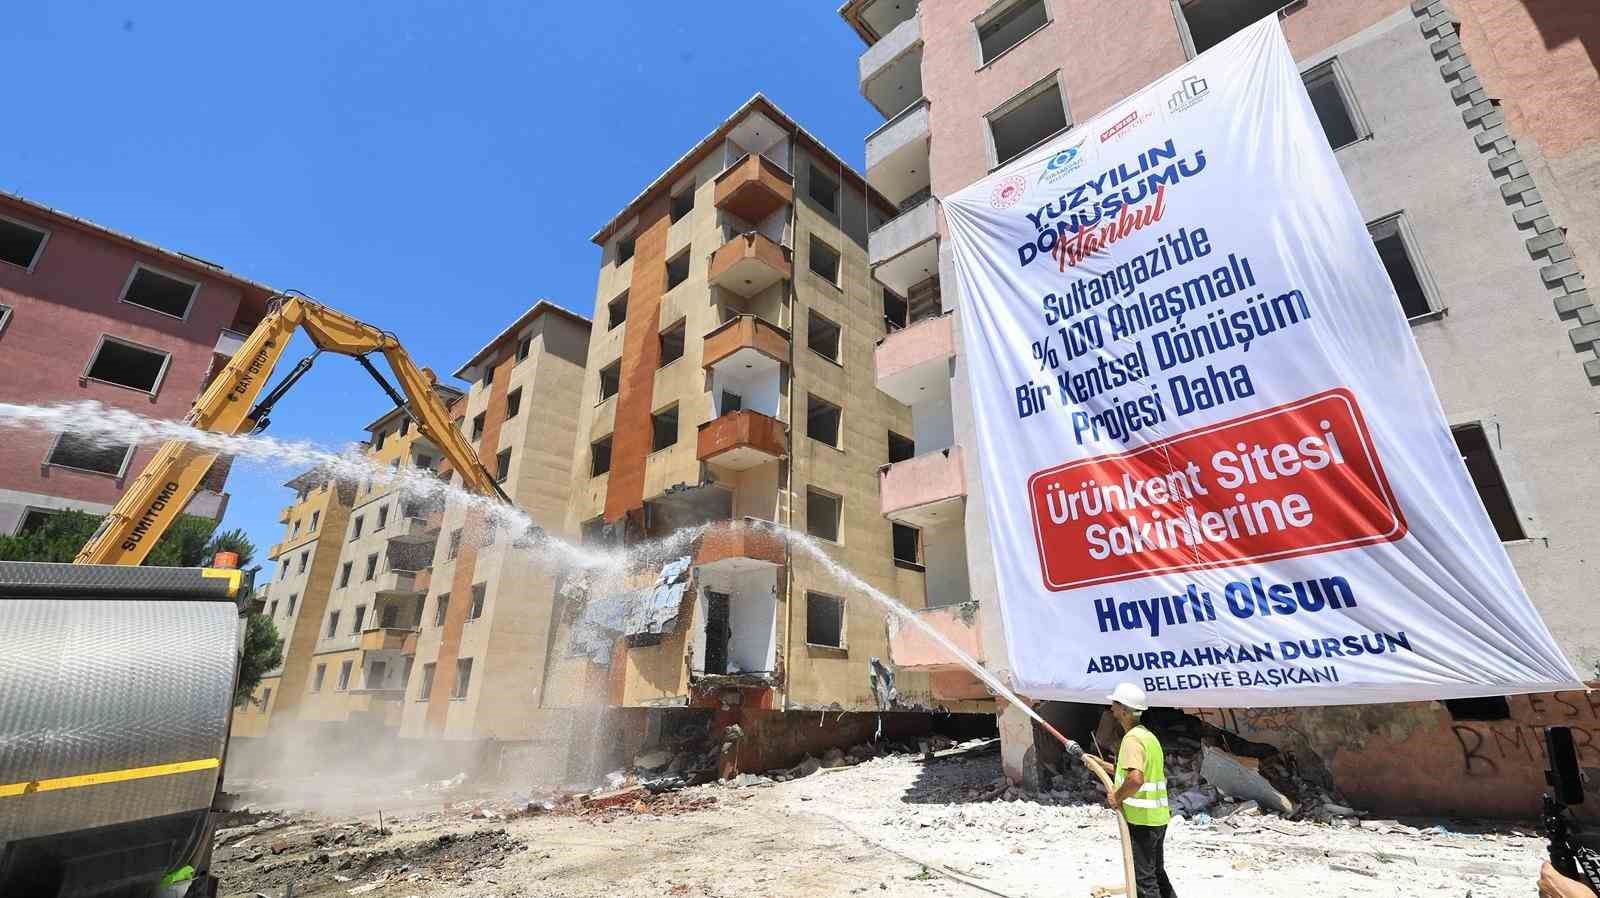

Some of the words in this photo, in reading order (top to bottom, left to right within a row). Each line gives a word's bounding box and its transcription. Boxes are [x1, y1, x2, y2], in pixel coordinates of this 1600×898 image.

[1031, 336, 1059, 372] %
[1058, 315, 1104, 361] 100
[1107, 253, 1256, 342] Anlaşmalı
[1043, 227, 1211, 326] Sultangazi'de
[1015, 381, 1051, 419] Bir
[1057, 341, 1150, 407] Kentsel
[1152, 289, 1311, 371] Dönüşüm
[1072, 384, 1167, 446] Projesi
[1168, 364, 1255, 417] Daha
[1045, 462, 1208, 525] Ürünkent
[1211, 419, 1345, 490] Sitesi
[121, 481, 179, 551] SUMITOMO
[1085, 492, 1313, 561] Sakinlerine
[1094, 584, 1217, 637] Hayırlı
[1225, 575, 1358, 620] Olsun
[1086, 642, 1275, 674] ABDURRAHMAN
[1279, 631, 1412, 660] DURSUN
[1143, 671, 1234, 693] BELEDİYE
[1238, 664, 1340, 689] BAŞKANI
